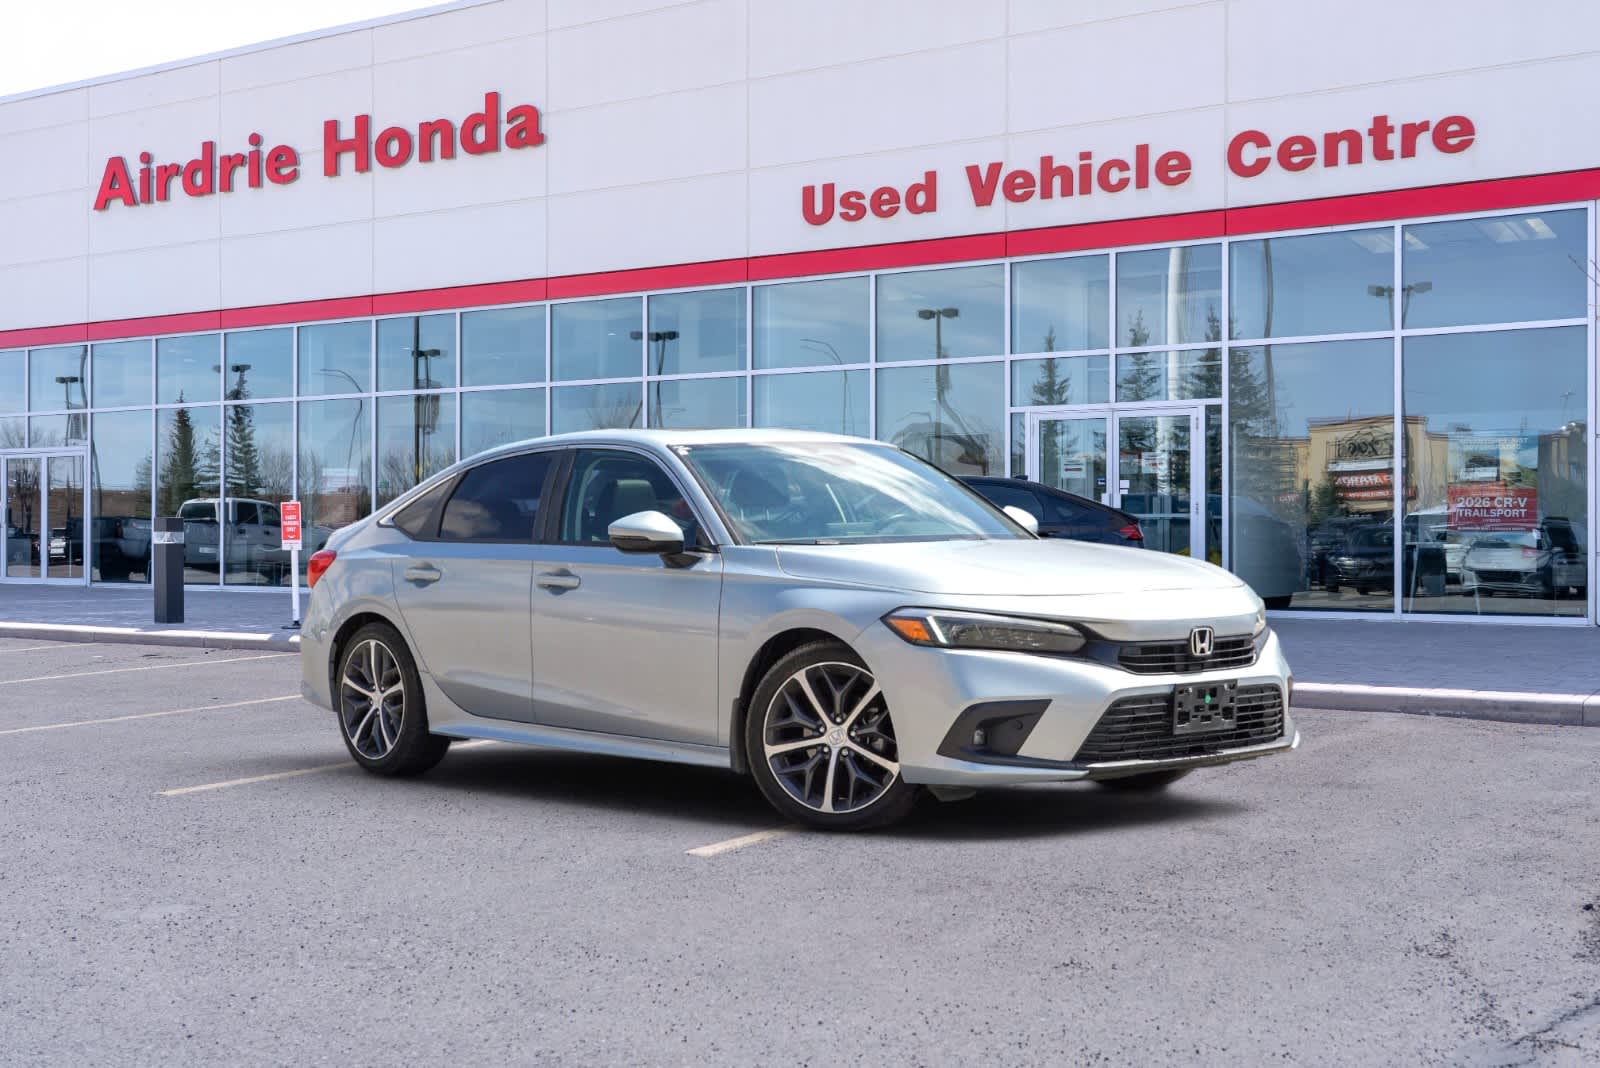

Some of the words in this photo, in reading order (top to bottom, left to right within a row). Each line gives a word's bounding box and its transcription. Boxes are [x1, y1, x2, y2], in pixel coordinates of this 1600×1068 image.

[94, 133, 299, 211] Airdrie
[323, 91, 546, 177] Honda
[801, 170, 937, 226] Used
[965, 143, 1192, 207] Vehicle
[1226, 114, 1476, 178] Centre
[1456, 497, 1490, 508] 2026
[1494, 497, 1527, 508] CR-V
[1457, 508, 1527, 518] TRAILSPORT
